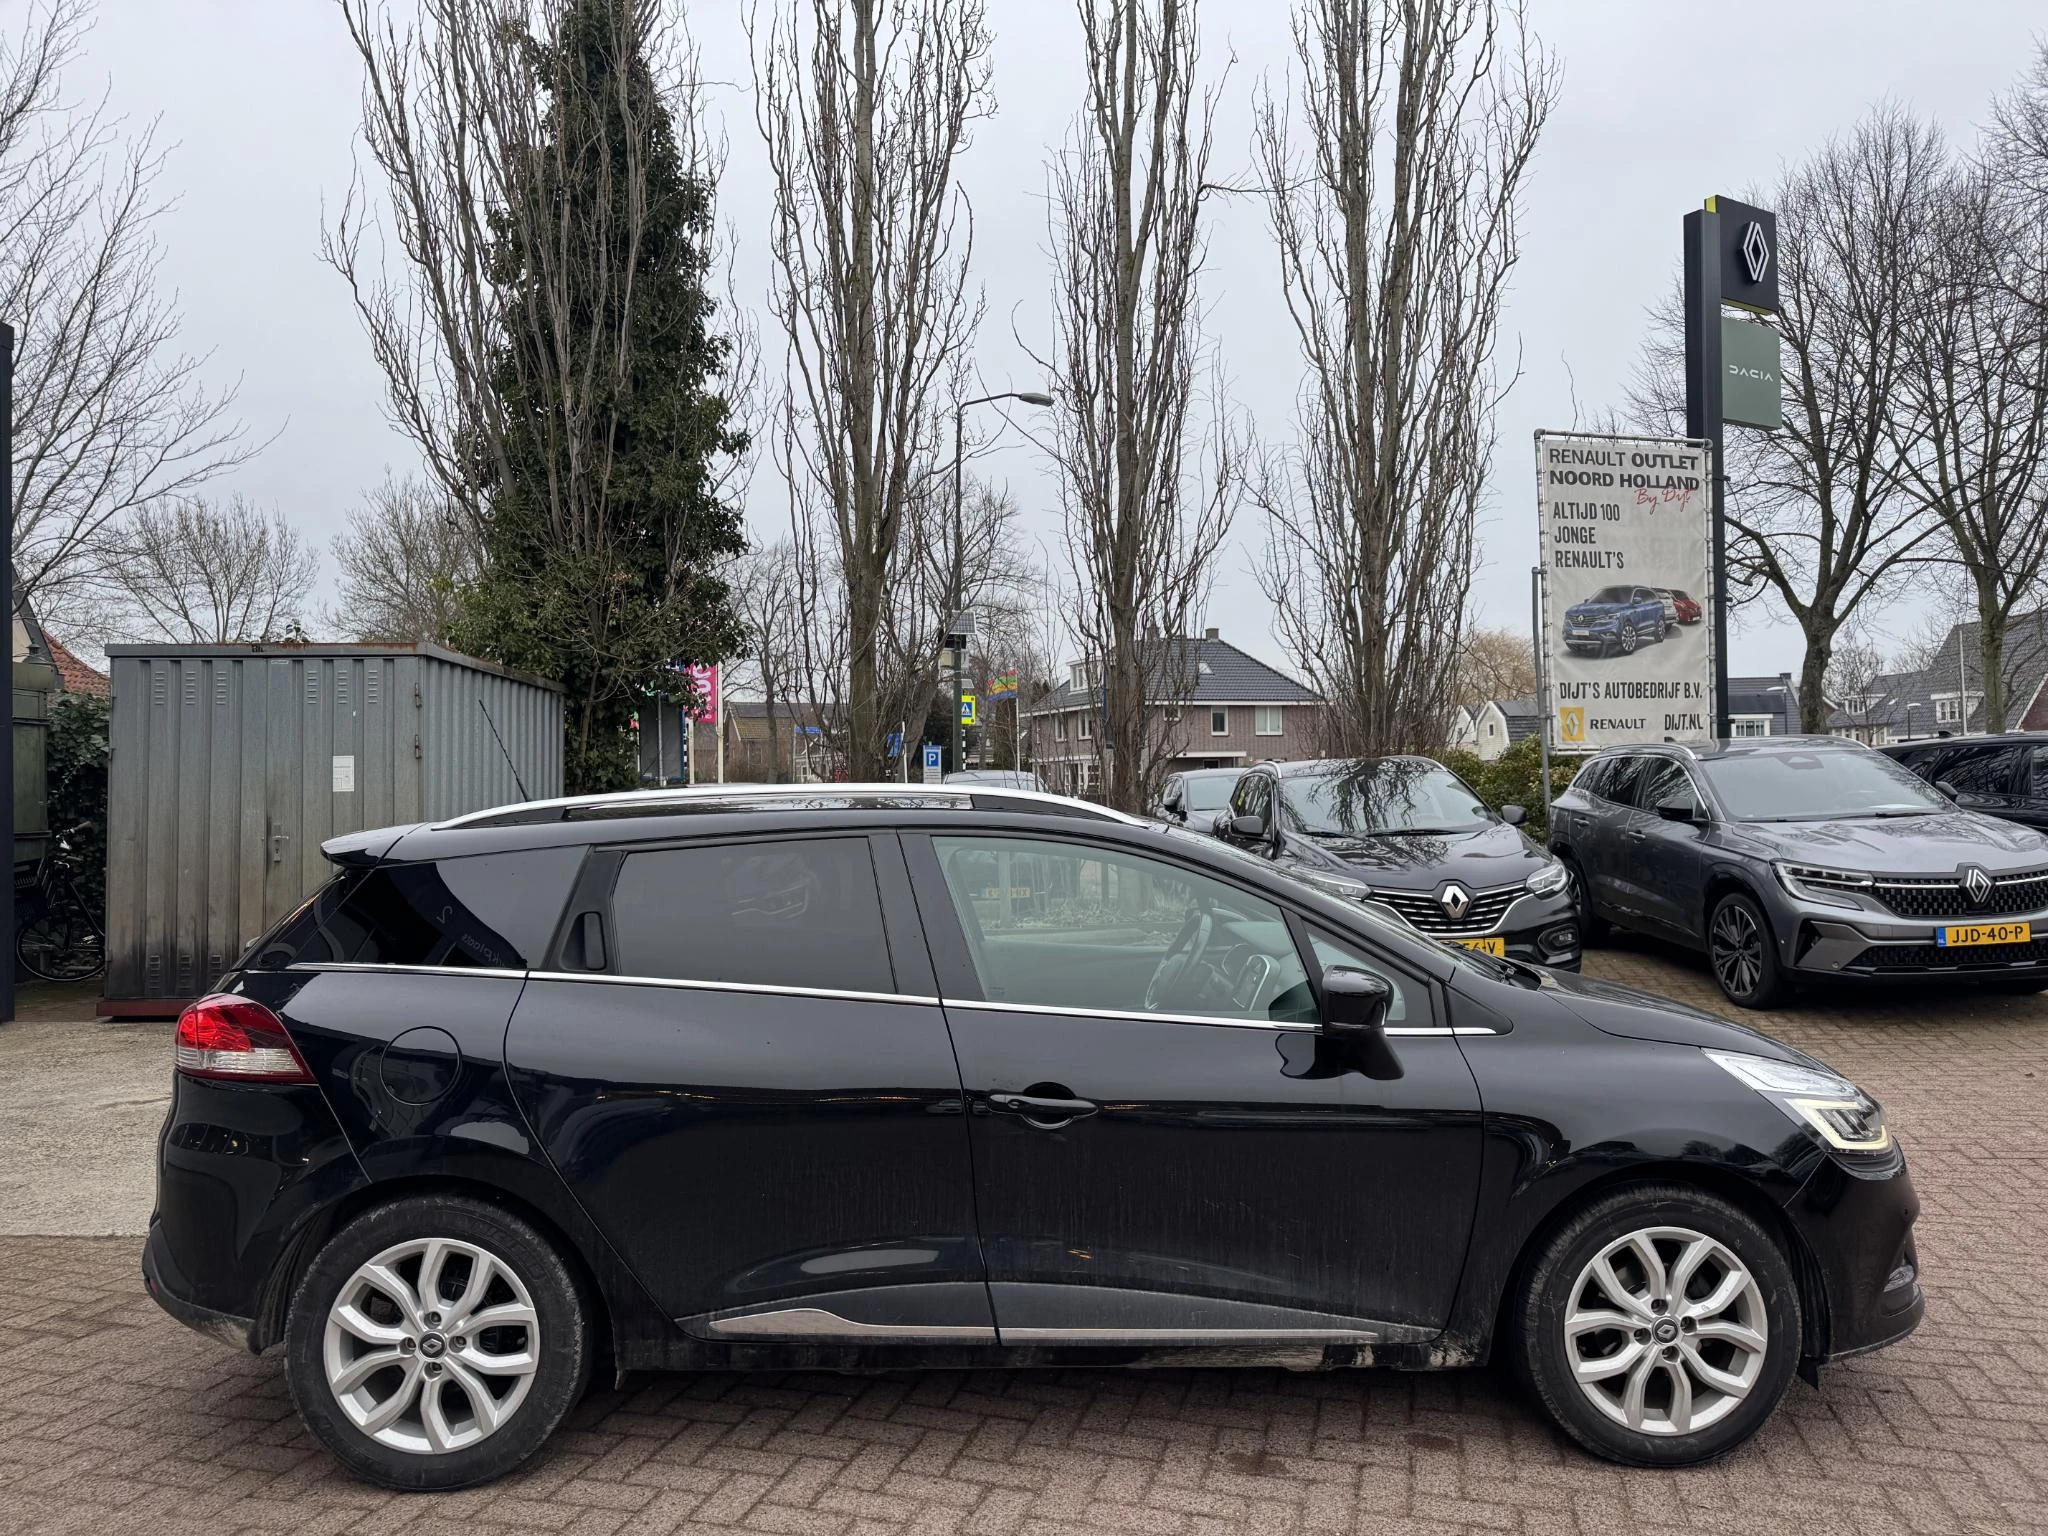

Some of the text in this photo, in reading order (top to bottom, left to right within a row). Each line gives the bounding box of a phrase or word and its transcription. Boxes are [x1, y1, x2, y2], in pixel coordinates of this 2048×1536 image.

[1729, 364, 1774, 382] DACIA
[1549, 448, 1699, 470] RENAULT OUTLET
[1550, 470, 1700, 490] NOORD HOLLAND
[1634, 488, 1660, 515] By
[1553, 501, 1620, 521] ALTIJD 100
[1554, 526, 1596, 544] JONGE
[1555, 550, 1624, 569] RENAULT'S
[1560, 682, 1703, 699] DIJT'S AUTOBEDRIJF B.V.
[1590, 718, 1646, 730] RENAULT
[1664, 713, 1703, 731] DIJT.NL
[928, 753, 936, 766] P
[1952, 926, 2024, 943] JJD-40-P
